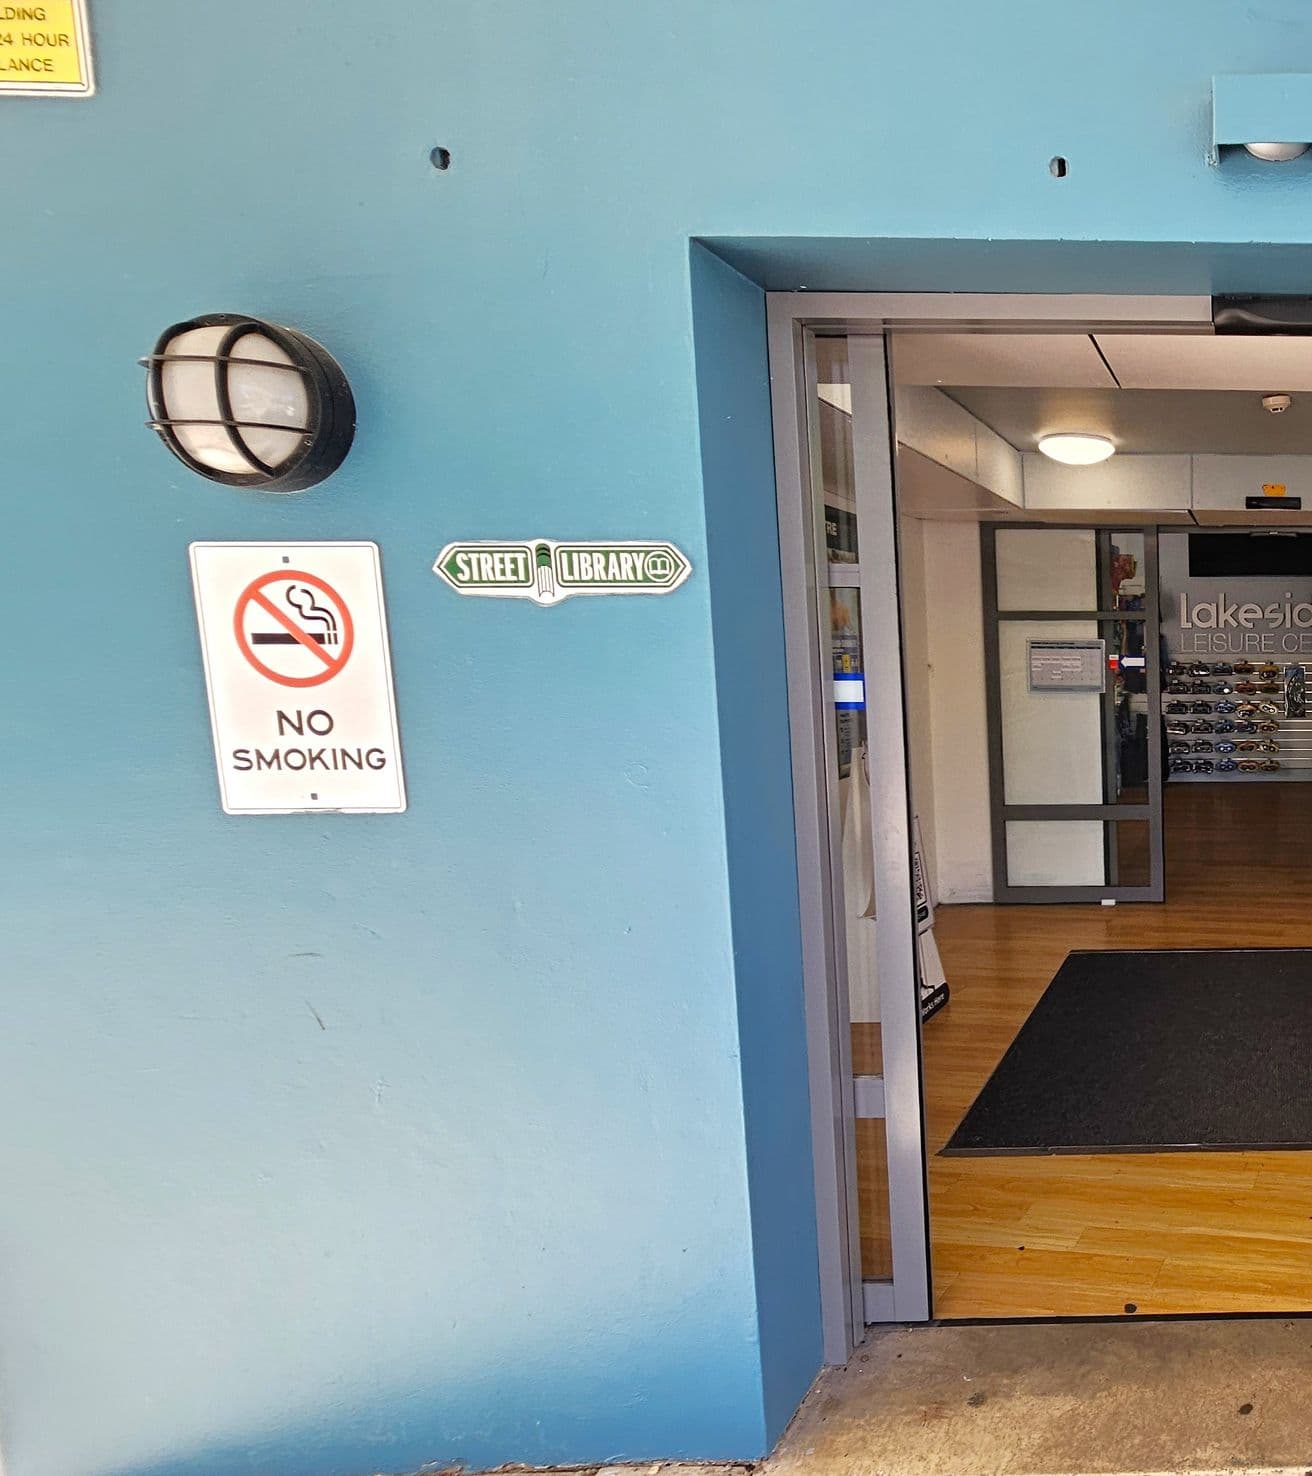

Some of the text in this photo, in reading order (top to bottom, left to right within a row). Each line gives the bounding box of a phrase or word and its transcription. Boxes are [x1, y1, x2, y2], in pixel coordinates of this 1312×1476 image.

[21, 32, 70, 47] HOUR
[455, 551, 646, 582] STREET LIBRARY
[1180, 633, 1275, 653] LEISURE
[276, 709, 334, 736] NO
[232, 747, 387, 771] SMOKING
